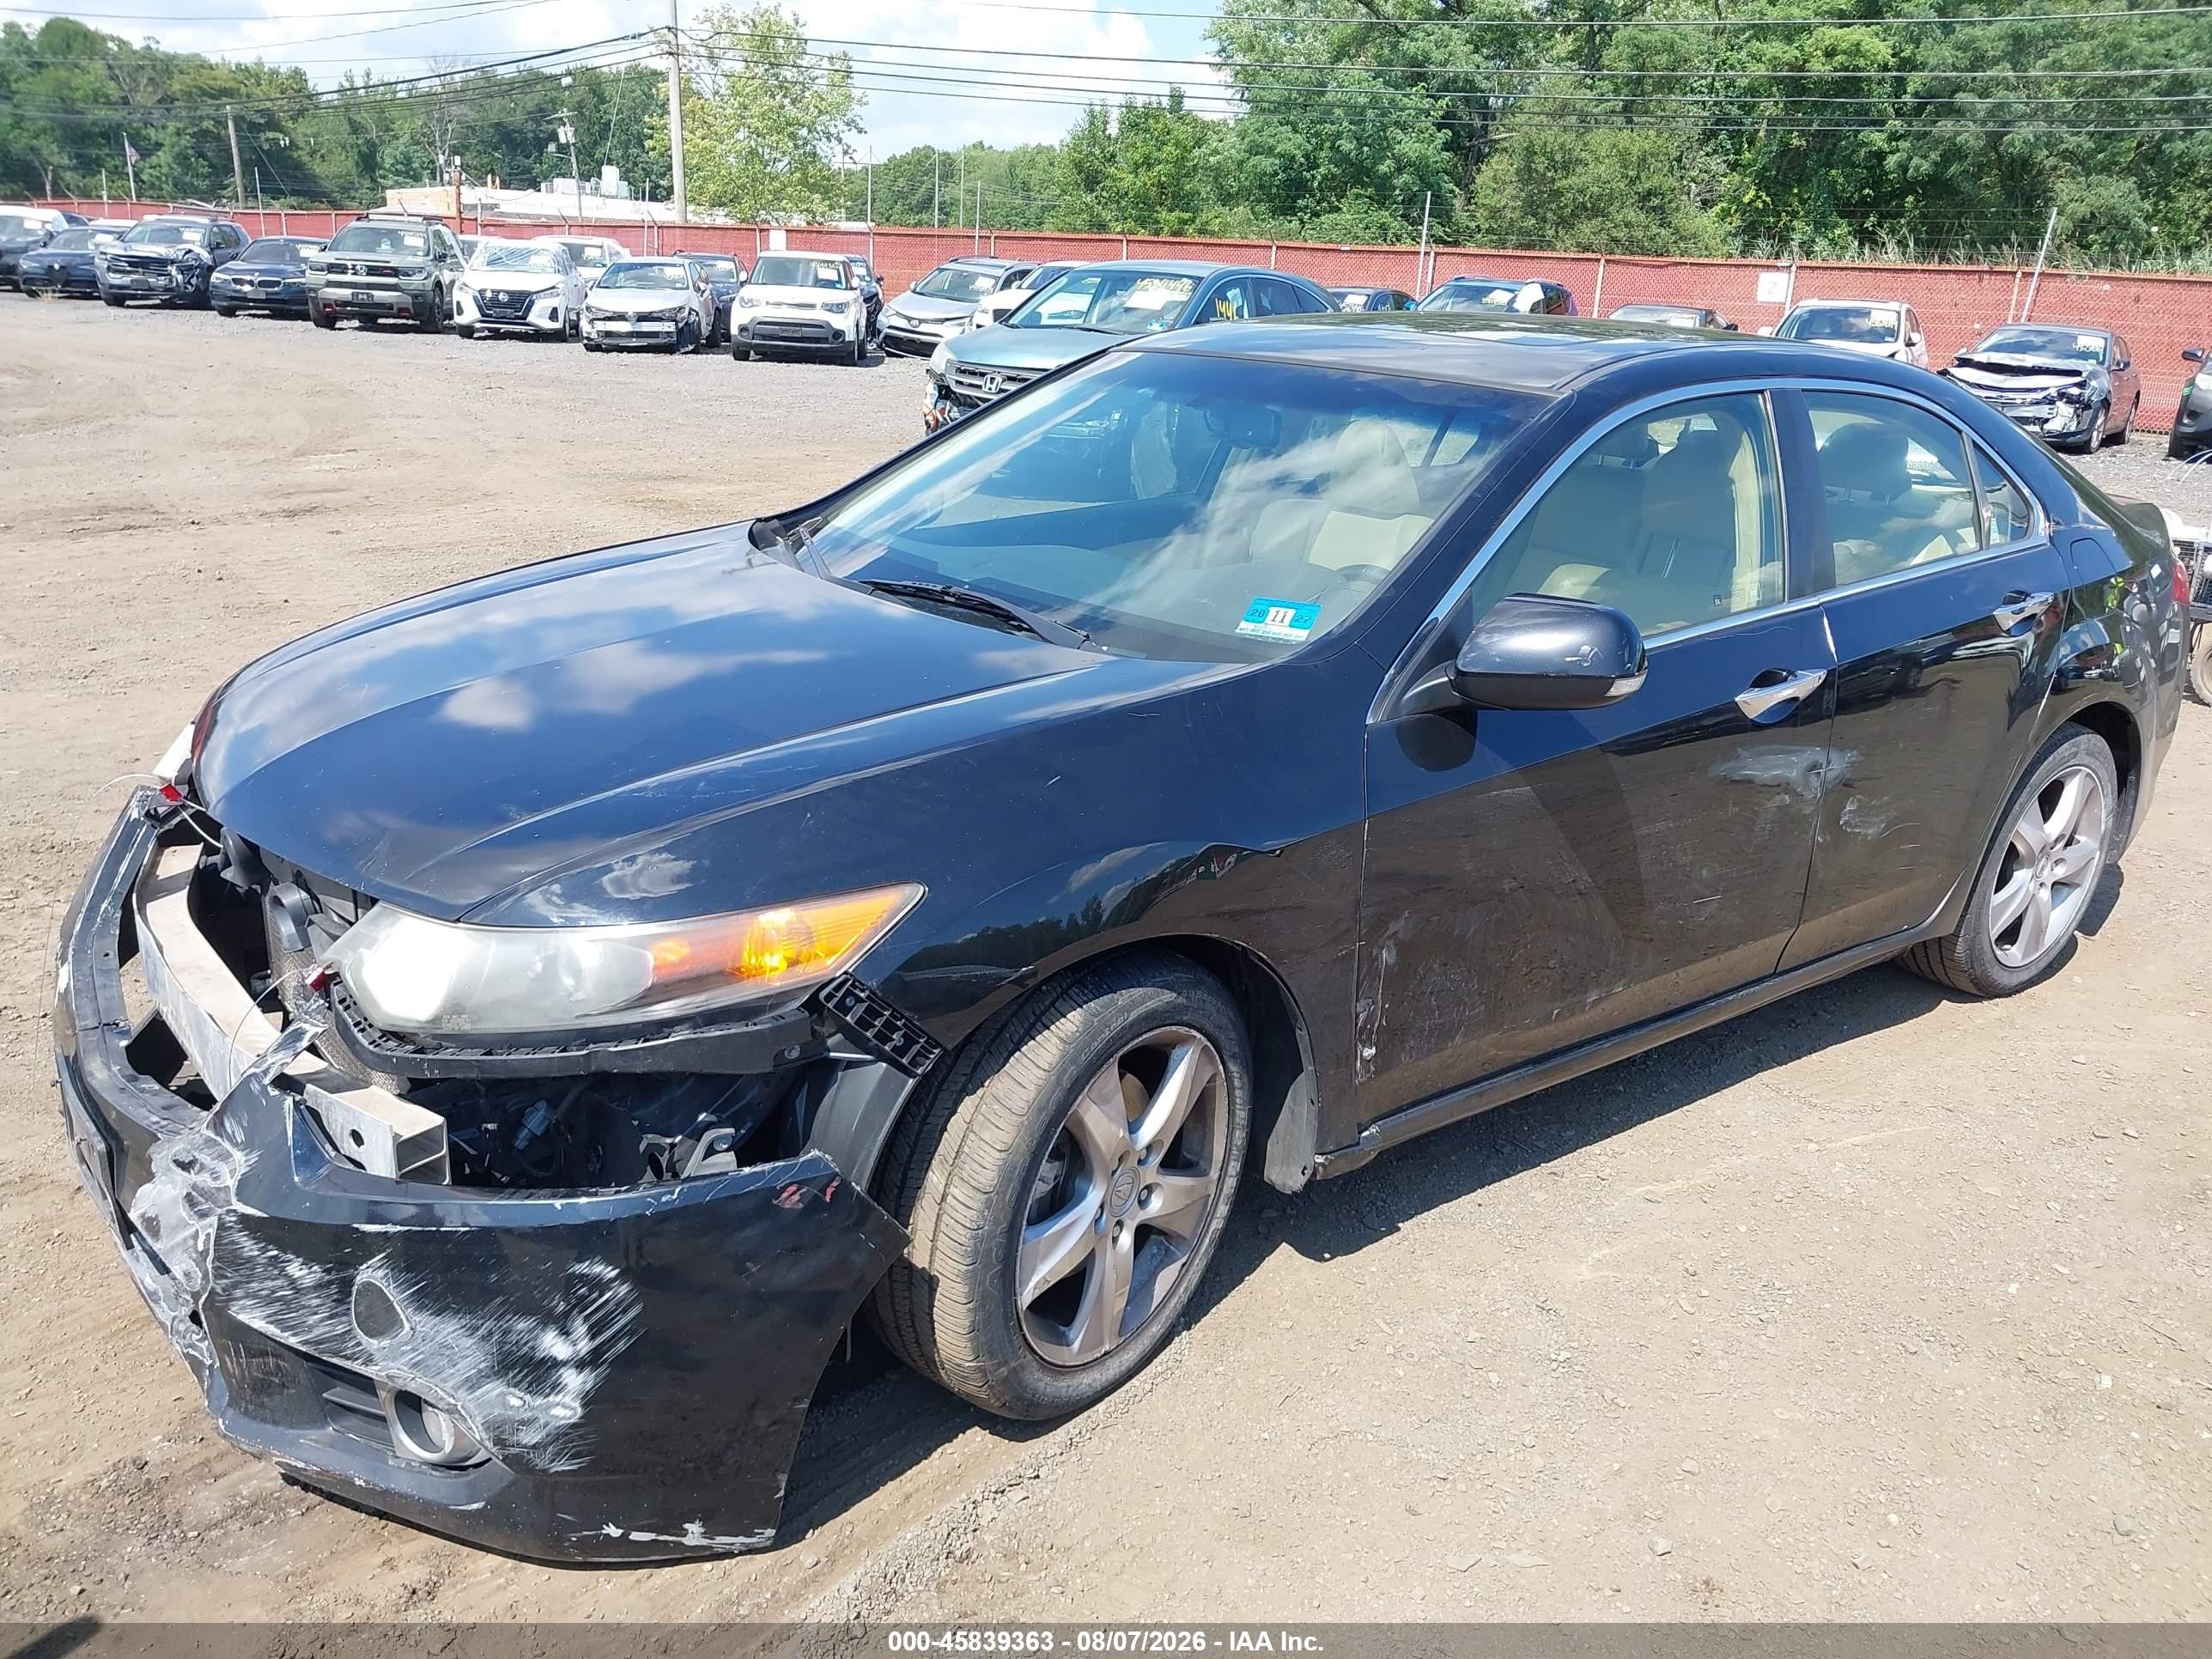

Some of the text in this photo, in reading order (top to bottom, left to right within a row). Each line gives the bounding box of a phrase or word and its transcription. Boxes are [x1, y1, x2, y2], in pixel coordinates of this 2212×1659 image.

[1249, 608, 1312, 623] 20 11 27
[1081, 1011, 1129, 1066] Control
